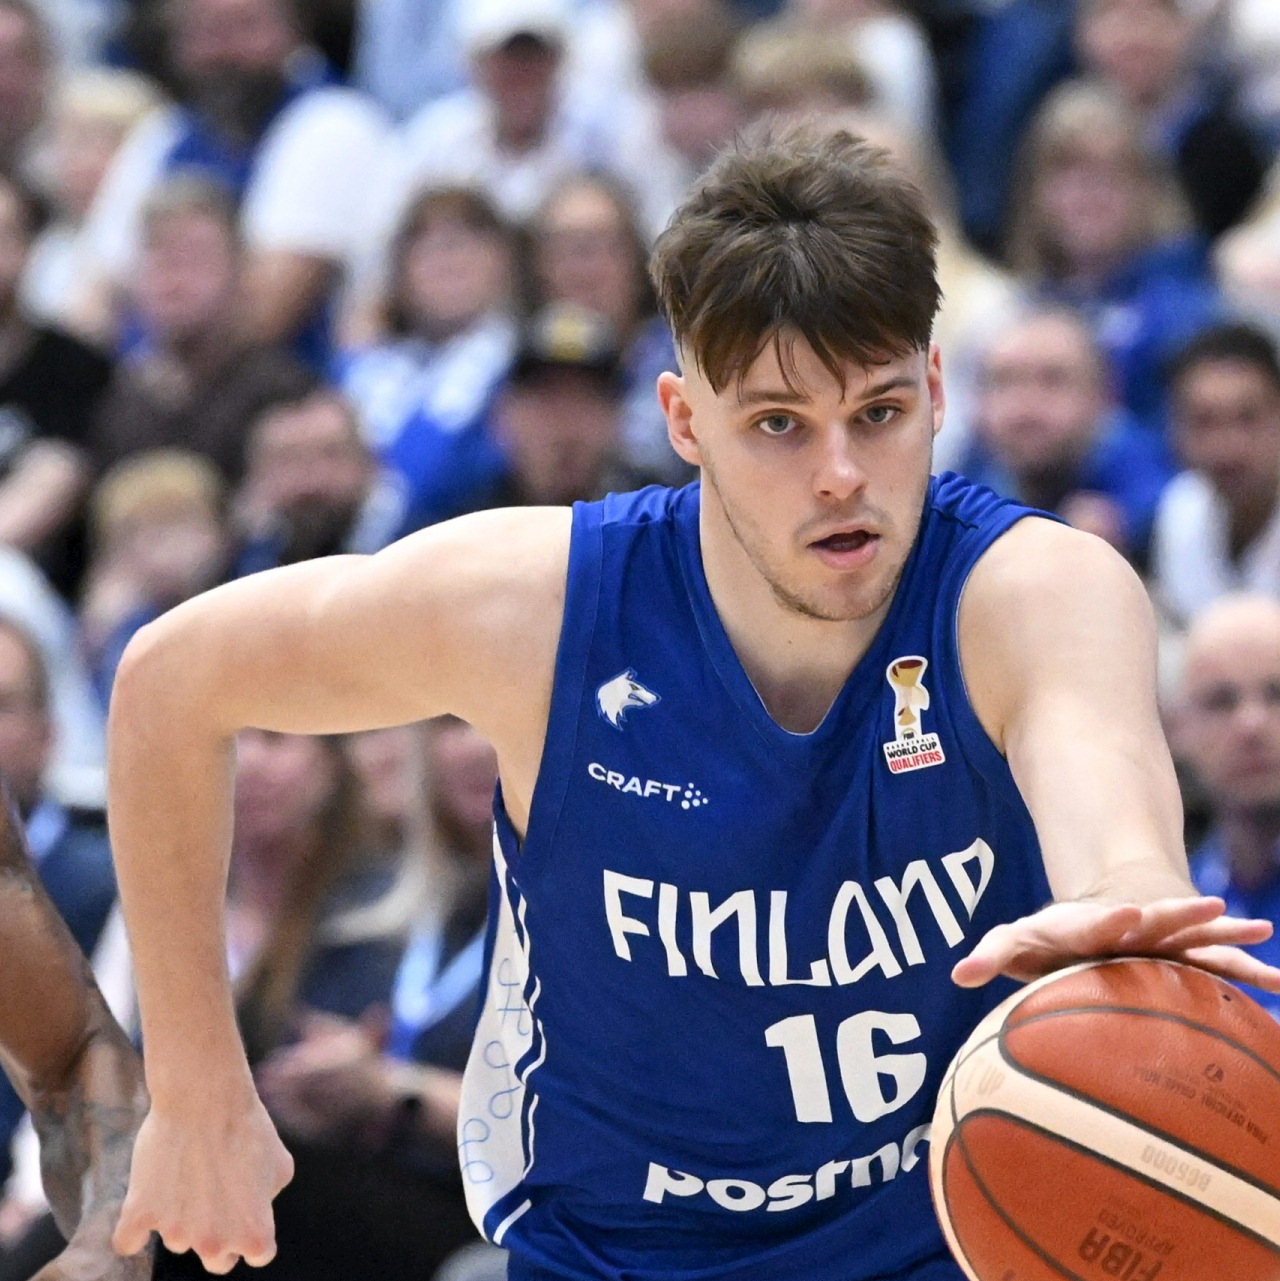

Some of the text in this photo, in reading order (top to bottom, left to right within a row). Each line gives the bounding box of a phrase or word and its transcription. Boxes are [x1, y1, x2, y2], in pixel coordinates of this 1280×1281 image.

[887, 741, 938, 759] WORLD CUP
[889, 750, 942, 772] QUALIFIERS
[588, 762, 682, 802] CRAFT
[603, 837, 995, 987] FINLAND
[764, 1010, 928, 1124] 16
